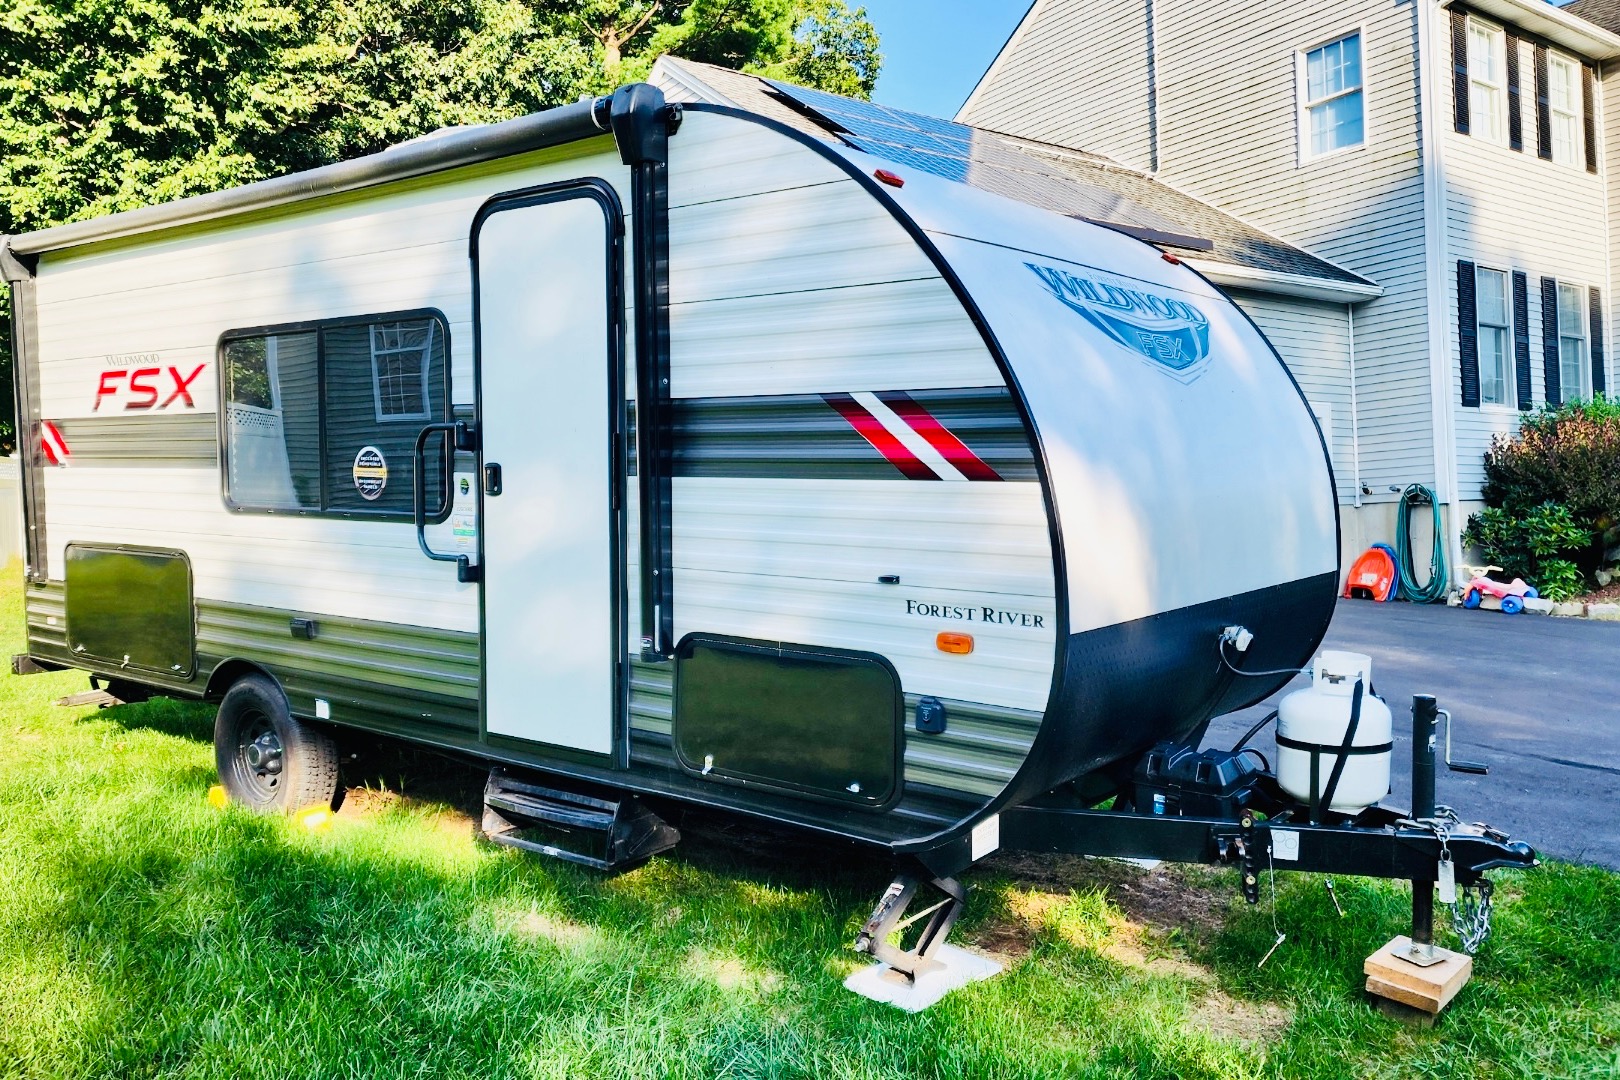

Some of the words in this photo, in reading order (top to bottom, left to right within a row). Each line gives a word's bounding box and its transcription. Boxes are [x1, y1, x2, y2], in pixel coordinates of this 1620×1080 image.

[1023, 262, 1207, 326] WILDWOOD
[106, 354, 160, 366] WILDWOOD
[1136, 331, 1191, 361] FSX
[92, 363, 206, 412] FSX
[906, 600, 976, 621] FOREST
[980, 607, 1045, 629] RIVER
